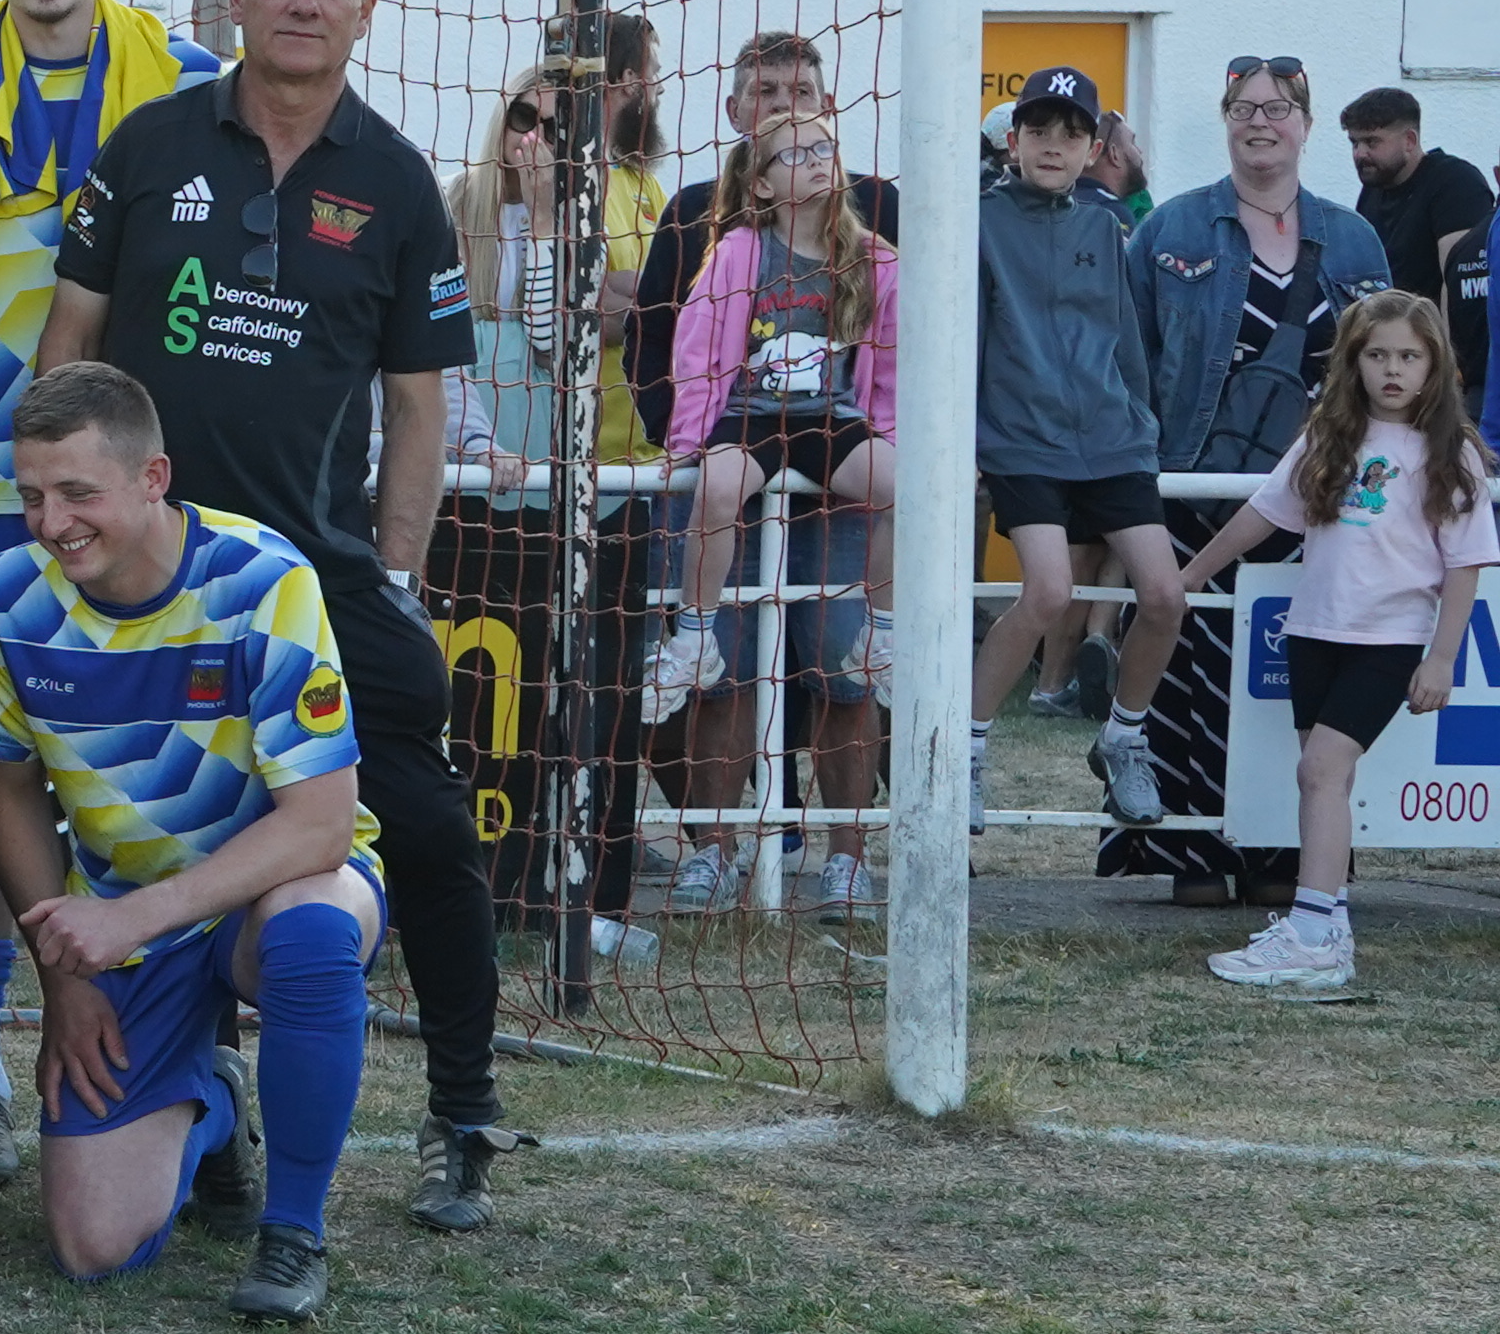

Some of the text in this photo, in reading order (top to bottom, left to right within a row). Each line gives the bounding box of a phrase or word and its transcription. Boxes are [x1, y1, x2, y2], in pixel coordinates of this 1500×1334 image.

[171, 201, 211, 222] MB
[25, 677, 75, 693] EXILE
[1400, 781, 1489, 823] 0800
